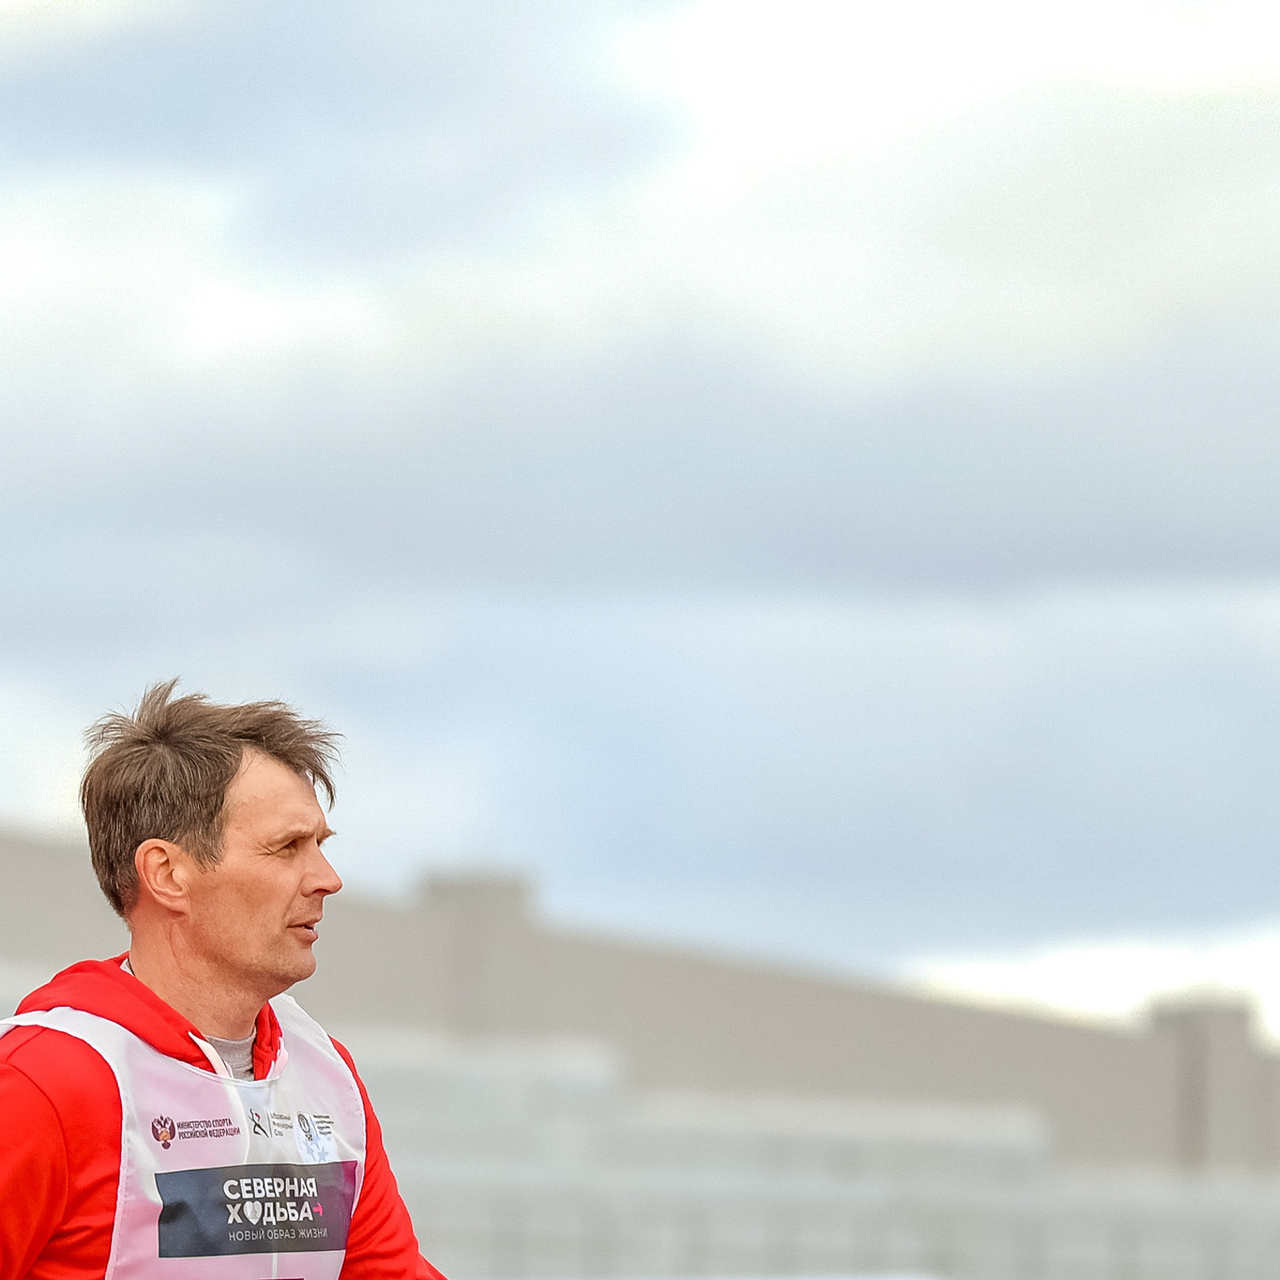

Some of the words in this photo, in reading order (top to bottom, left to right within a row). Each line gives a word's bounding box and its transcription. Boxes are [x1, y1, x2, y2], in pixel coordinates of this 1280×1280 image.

[223, 1177, 318, 1200] СЕВЕРНАЯ
[229, 1229, 265, 1242] НОВЫЙ
[266, 1229, 296, 1240] ОБРАЗ
[298, 1227, 328, 1238] ЖИЗНИ
